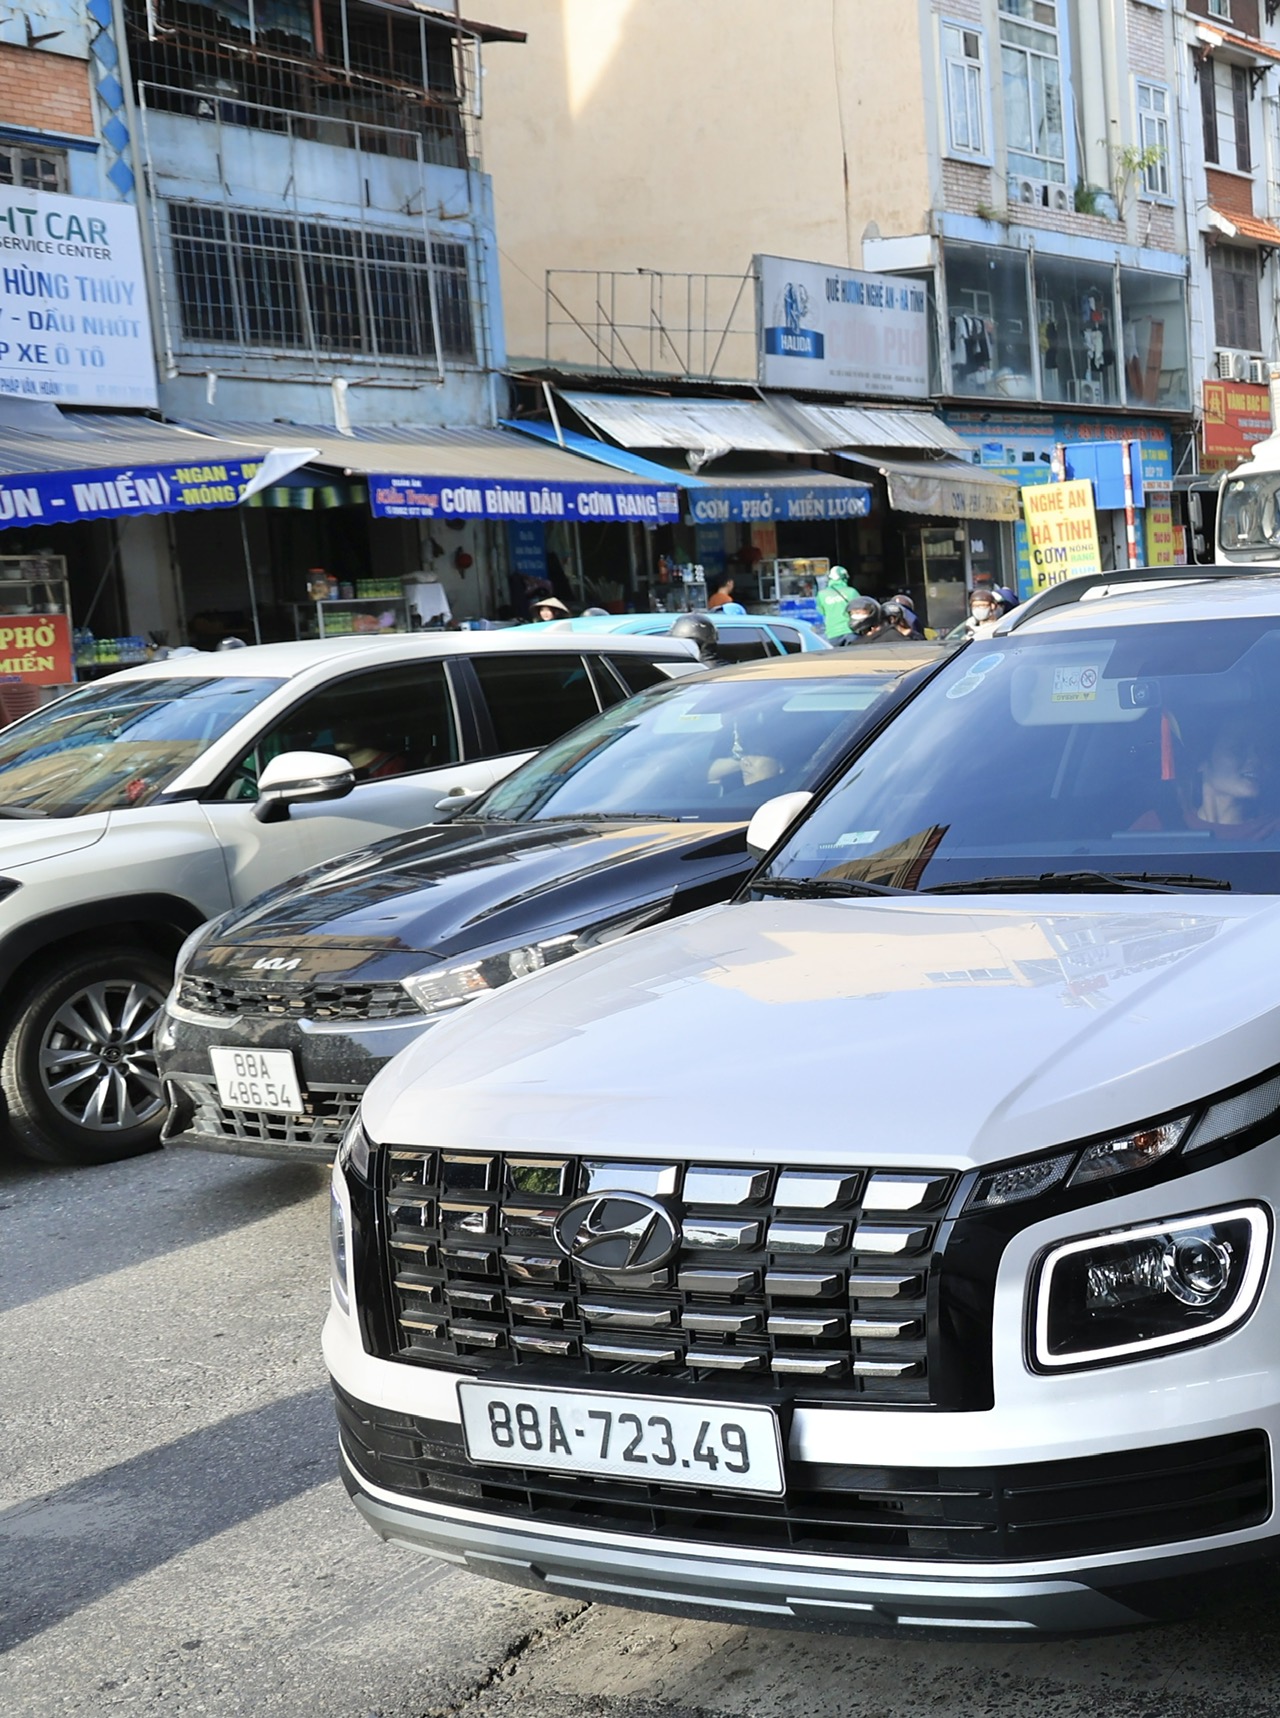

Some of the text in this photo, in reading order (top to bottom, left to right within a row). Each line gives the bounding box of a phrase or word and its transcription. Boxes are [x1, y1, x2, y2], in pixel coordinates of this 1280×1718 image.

[45, 211, 109, 246] CAR
[57, 243, 112, 261] CENTER
[3, 263, 70, 300] HÙNG
[28, 303, 76, 333] DẦU
[18, 343, 49, 364] XE
[54, 342, 71, 365] Ô
[74, 345, 105, 367] TÔ
[883, 315, 924, 367] PHỞ
[72, 472, 163, 512] MIẾN
[440, 487, 483, 513] CƠM
[485, 485, 528, 514] BÌNH
[529, 487, 565, 515] DÂN
[577, 491, 615, 515] CƠM
[617, 494, 658, 516] RANG
[741, 493, 773, 518] PHỞ
[788, 491, 825, 517] MIẾN
[1029, 488, 1065, 514] NGHỆ
[1068, 489, 1087, 509] AN
[1030, 518, 1093, 546] HÀ TĨNH
[1033, 546, 1068, 565] CƠM
[0, 618, 55, 650] PHỞ
[234, 1053, 270, 1080] 88A
[228, 1081, 292, 1108] 486.54
[487, 1400, 751, 1474] 88A-723.49
